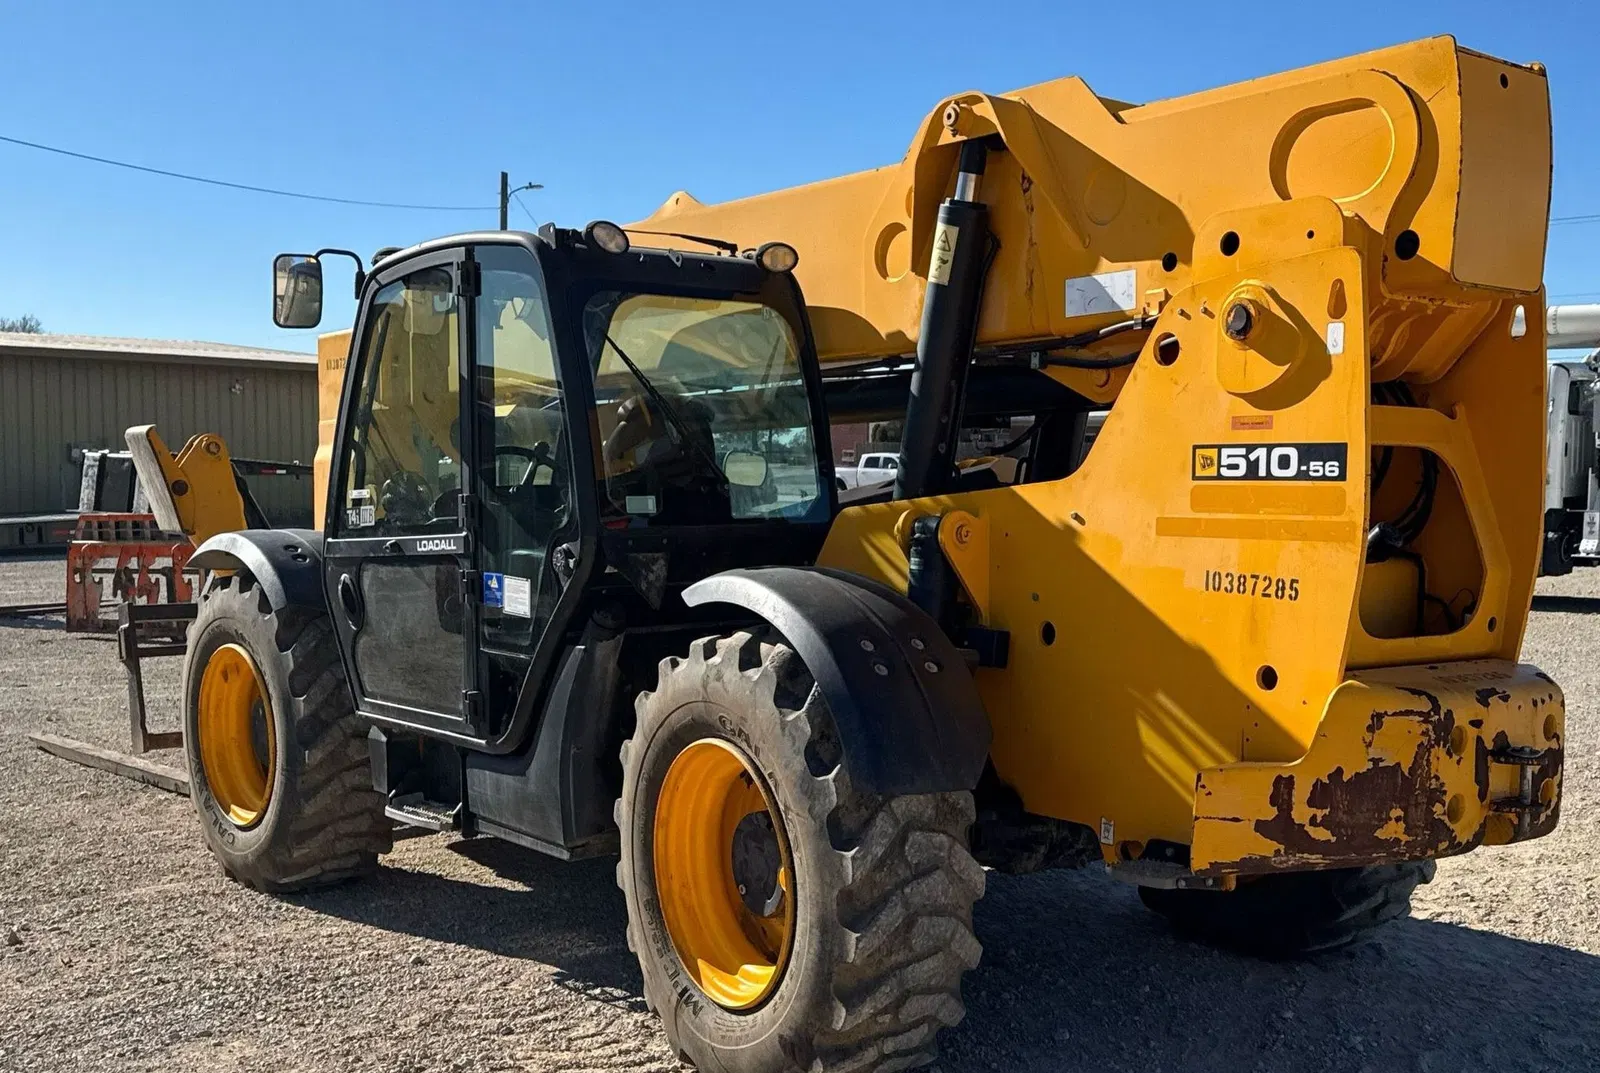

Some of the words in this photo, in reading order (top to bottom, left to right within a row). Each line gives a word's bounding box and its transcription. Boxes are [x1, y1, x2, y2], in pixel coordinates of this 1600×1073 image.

[1220, 447, 1339, 477] 510-56
[416, 539, 457, 552] LOADALL
[1205, 570, 1299, 601] 10387285
